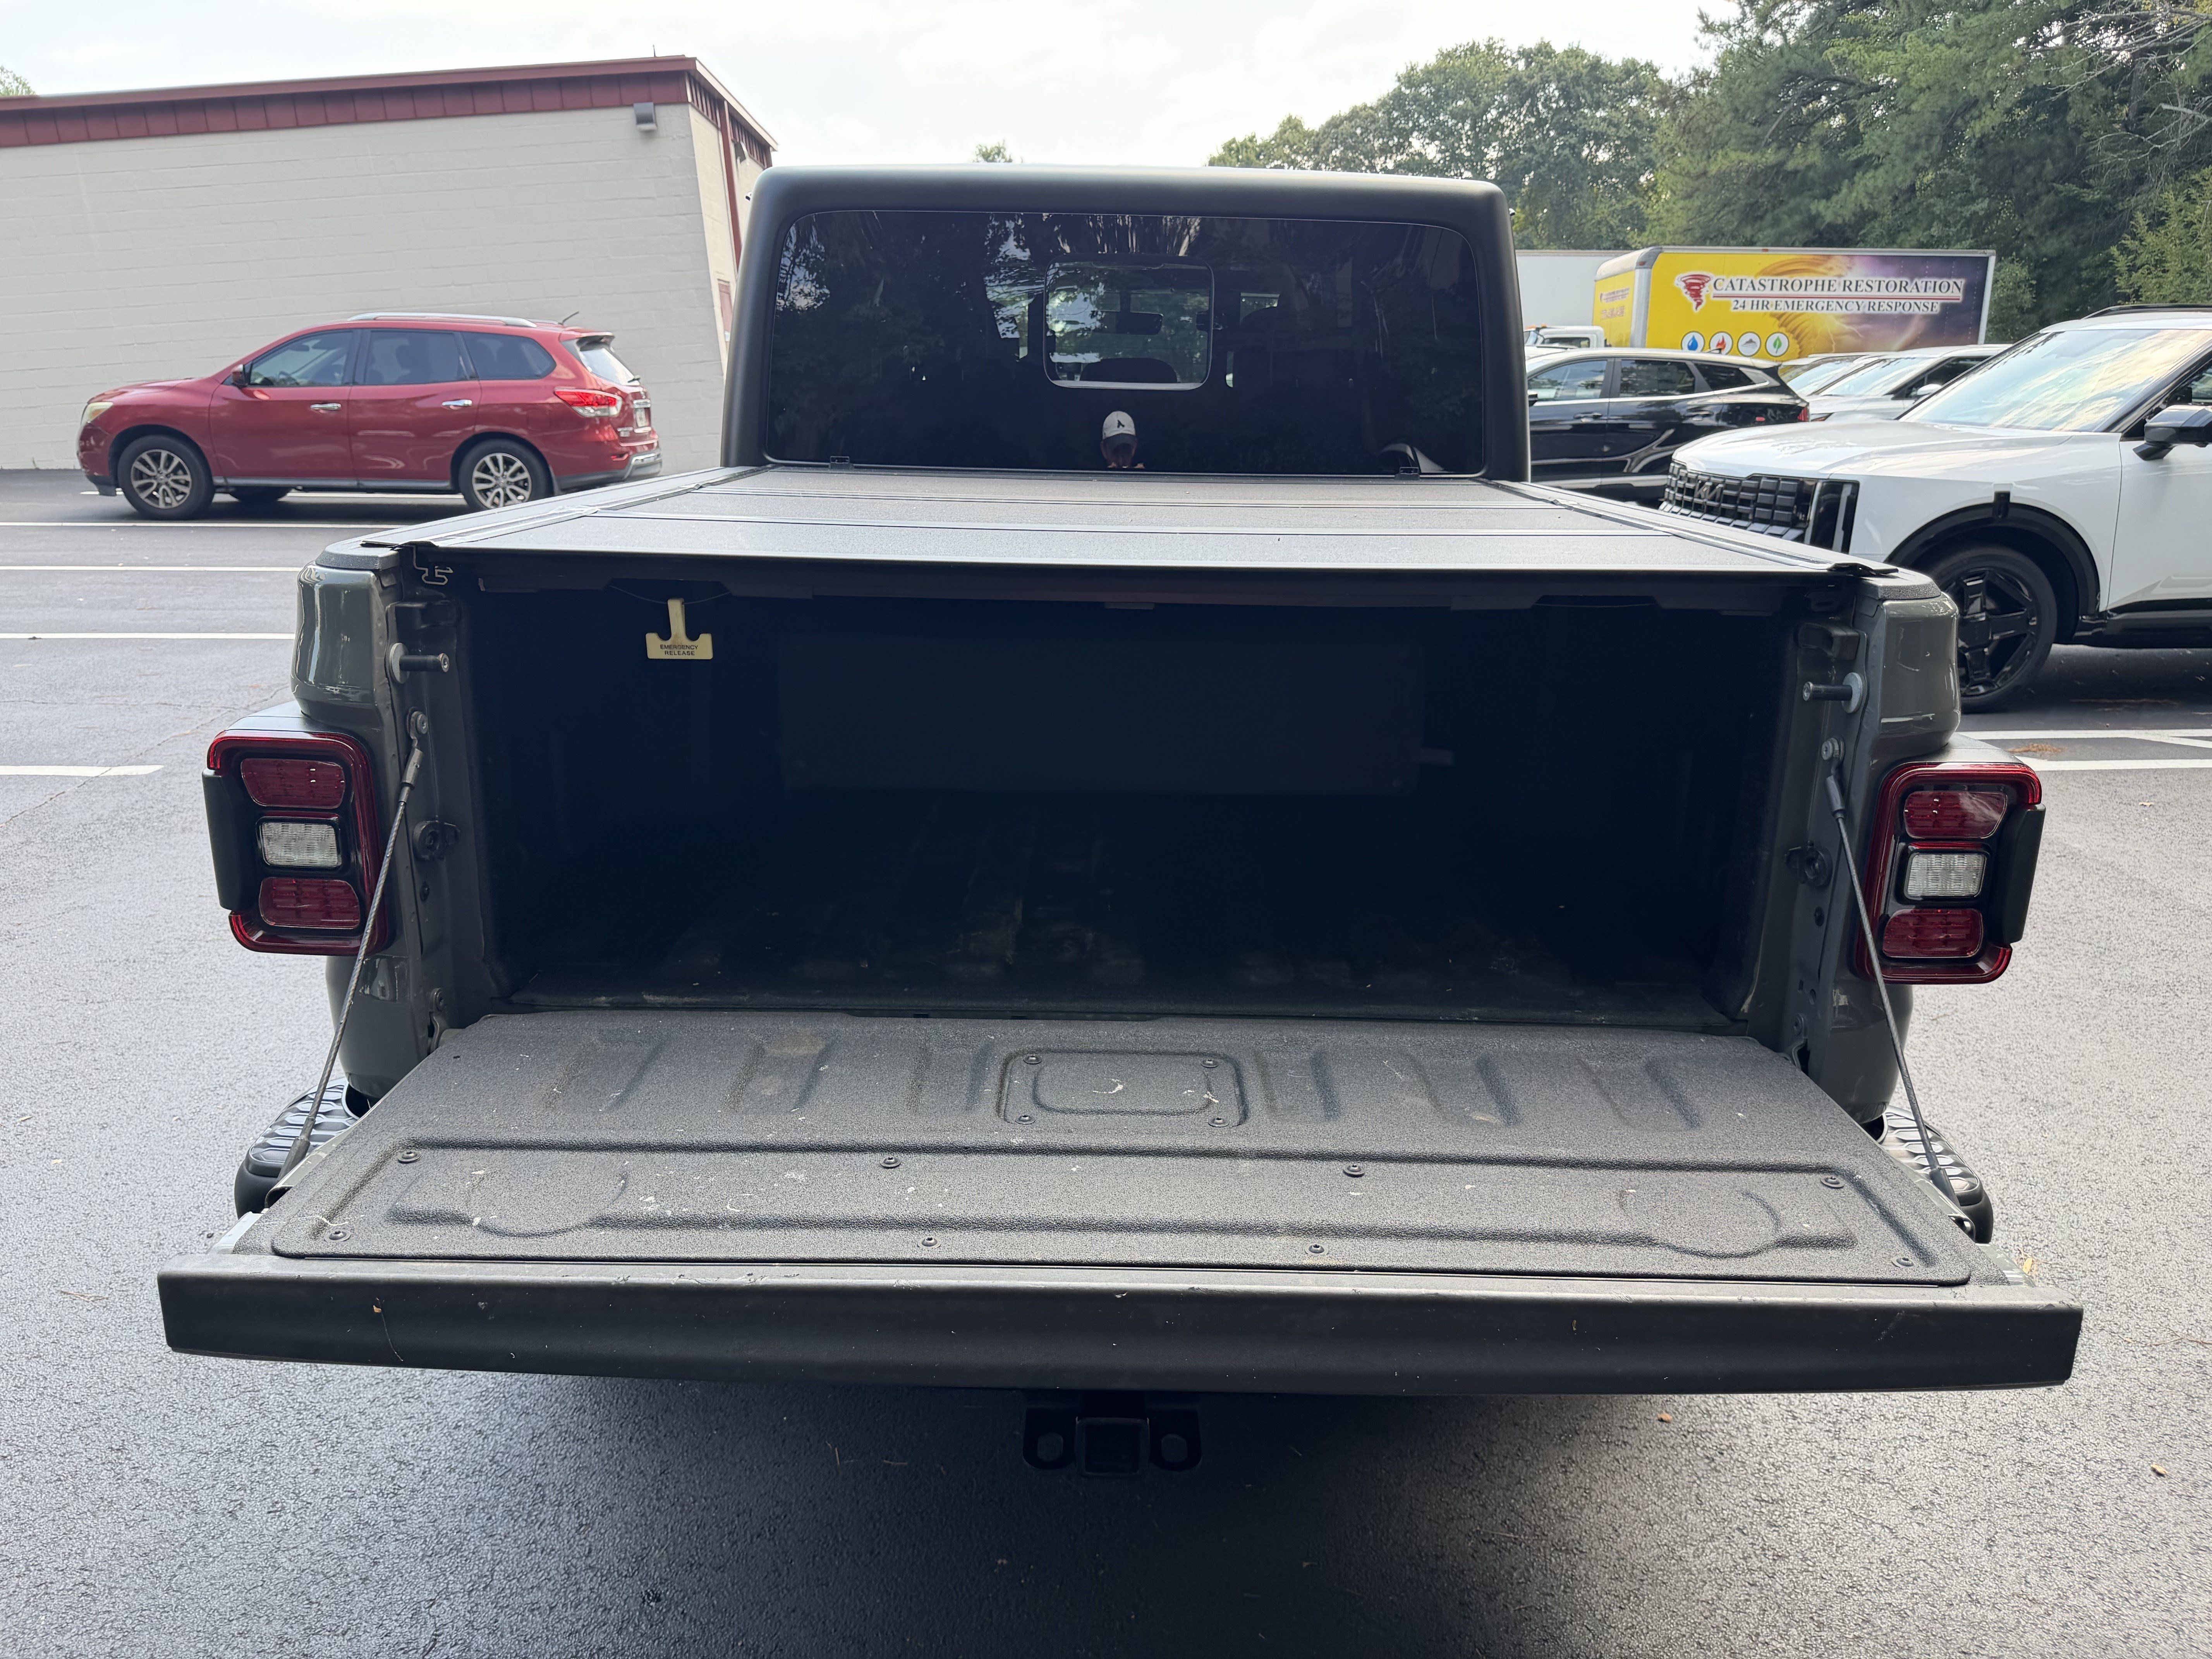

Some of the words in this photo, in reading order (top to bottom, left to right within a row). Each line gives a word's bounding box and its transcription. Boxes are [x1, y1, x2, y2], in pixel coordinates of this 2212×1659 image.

[1713, 278, 1837, 292] CATASTROPHE
[1842, 280, 1962, 293] RESTORATION
[1733, 300, 1746, 310] 24
[1750, 300, 1769, 310] HR
[1774, 300, 1864, 311] EMERGENCY
[1867, 301, 1938, 312] RESPONSE
